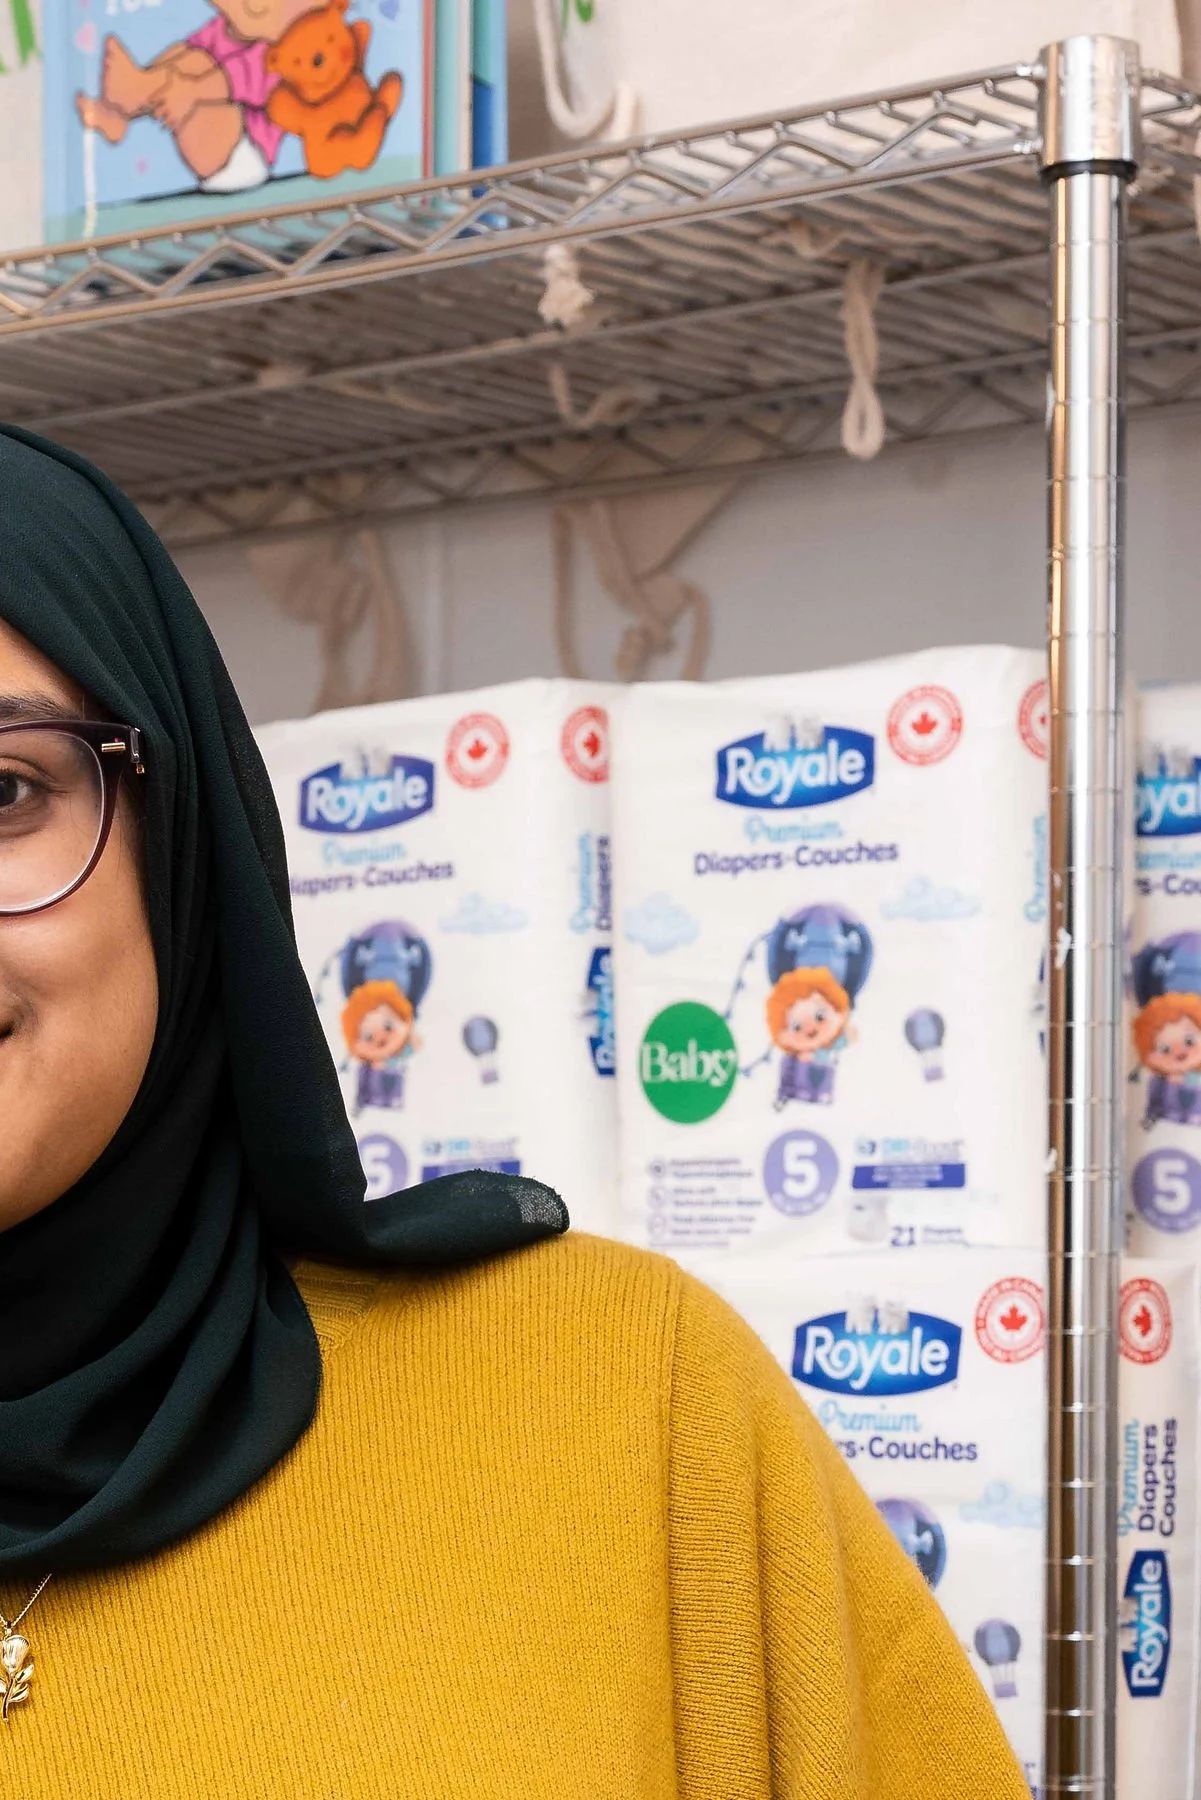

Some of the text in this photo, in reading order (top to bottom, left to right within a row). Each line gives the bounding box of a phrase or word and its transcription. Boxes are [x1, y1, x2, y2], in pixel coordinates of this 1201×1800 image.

[307, 765, 428, 831] Royale
[726, 739, 867, 805] Royale
[641, 1037, 738, 1087] Baby
[362, 1143, 393, 1198] 5
[783, 1138, 821, 1199] 5
[1153, 1158, 1191, 1215] 5
[803, 1325, 949, 1390] Royale
[819, 1398, 923, 1433] Premium
[1118, 1419, 1140, 1537] Premium
[1138, 1424, 1160, 1532] Diapers
[1159, 1417, 1177, 1537] Couches
[1131, 1559, 1168, 1688] Royale
